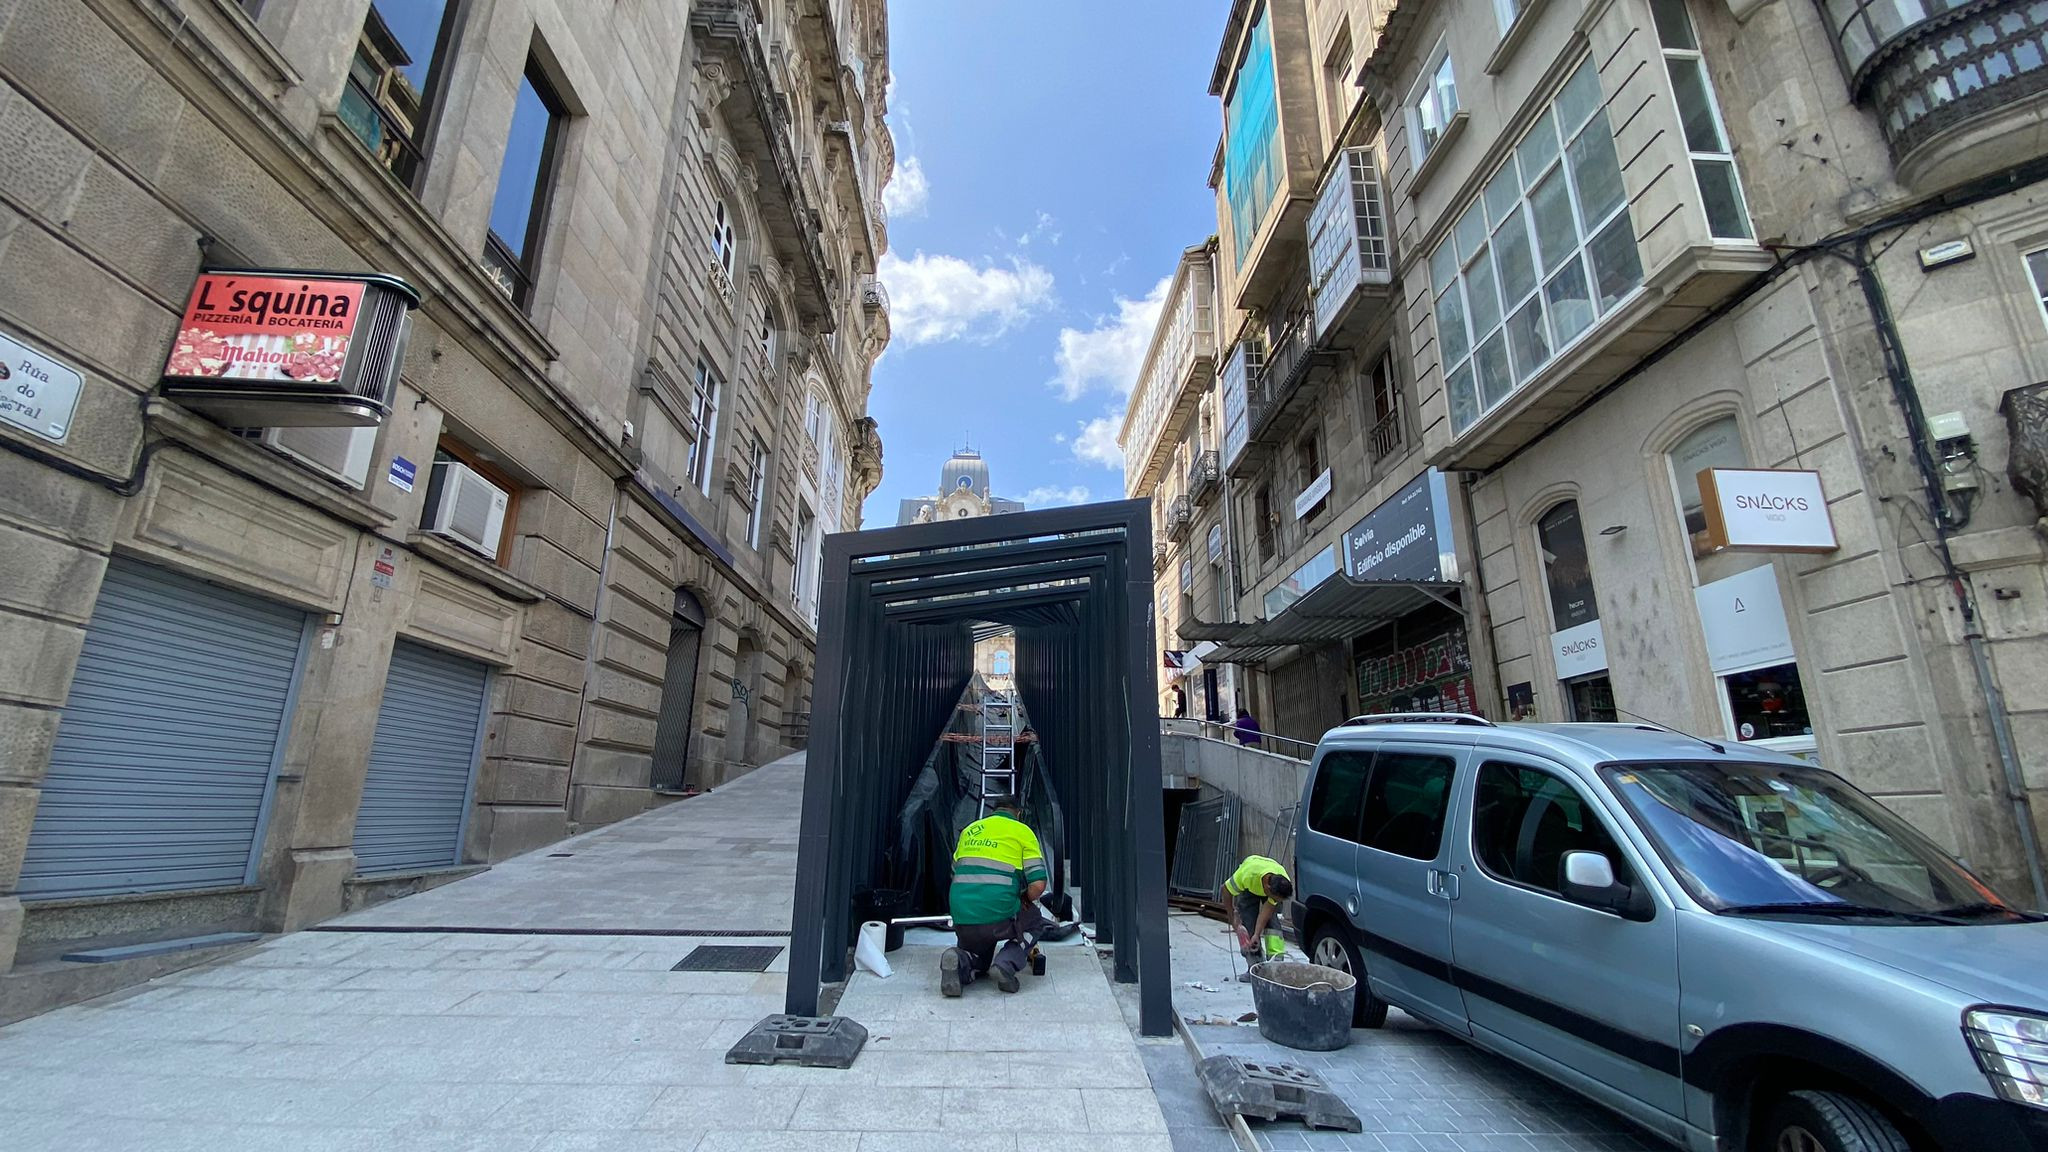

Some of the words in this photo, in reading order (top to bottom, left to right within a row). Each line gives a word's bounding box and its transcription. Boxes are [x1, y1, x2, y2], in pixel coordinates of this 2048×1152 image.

[193, 313, 253, 324] PIZZERÍA
[268, 316, 344, 329] BOCATERÍA
[220, 346, 296, 365] Mahou
[18, 360, 49, 383] Rúa
[17, 384, 35, 398] do
[1736, 493, 1808, 511] SNACKS
[1354, 528, 1374, 550] Solvia
[1357, 551, 1384, 576] Edificio
[1384, 523, 1426, 557] disponible
[1561, 637, 1597, 656] SNACKS
